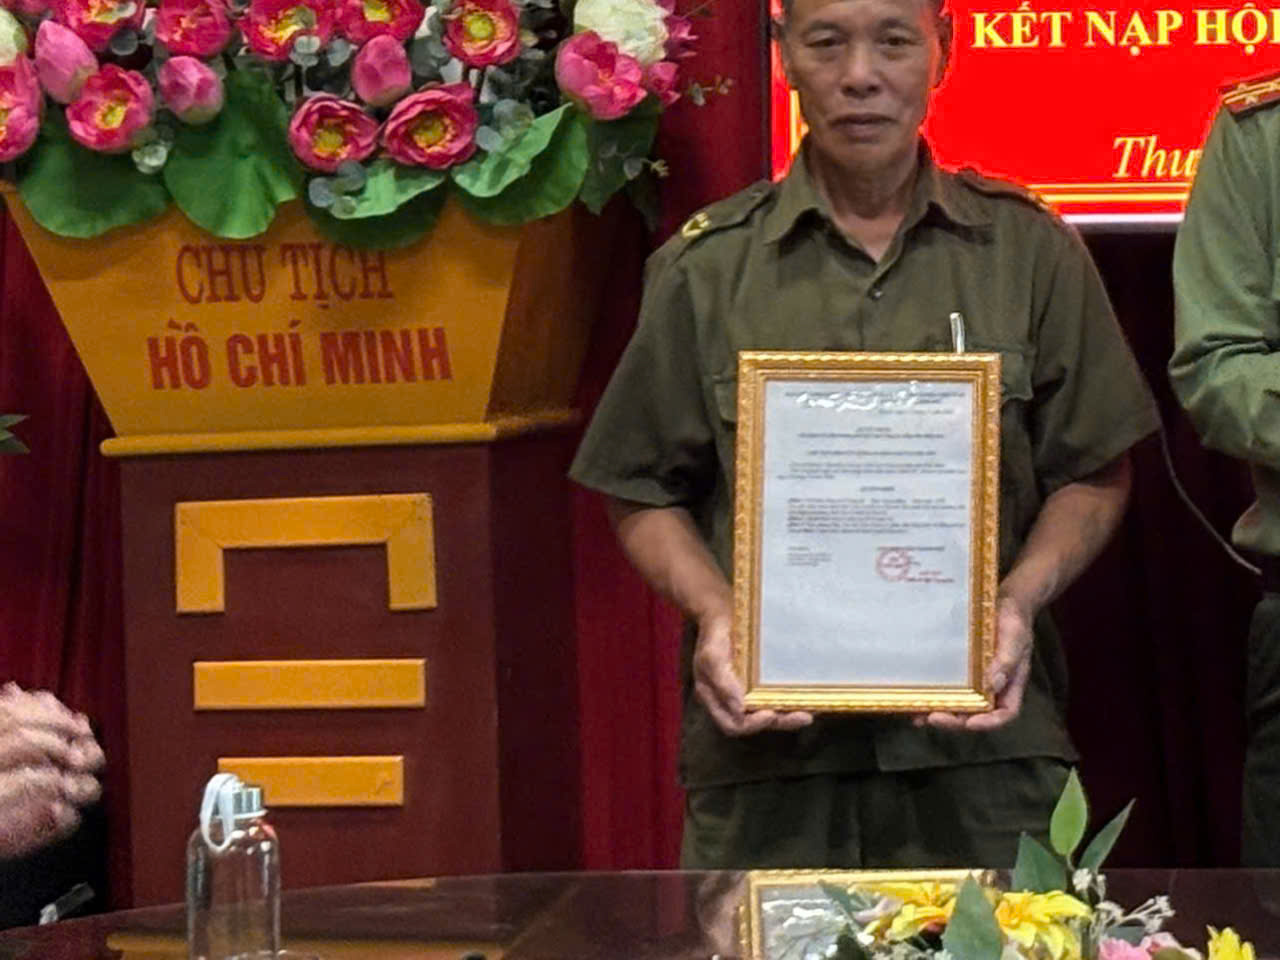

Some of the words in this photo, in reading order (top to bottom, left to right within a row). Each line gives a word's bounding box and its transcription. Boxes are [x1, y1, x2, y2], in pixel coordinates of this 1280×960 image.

[971, 0, 1073, 49] KẾT
[1084, 9, 1183, 56] NẠP
[279, 242, 394, 310] TỊCH
[147, 317, 212, 390] HỒ
[226, 319, 307, 388] CHÍ
[319, 327, 453, 386] MINH
